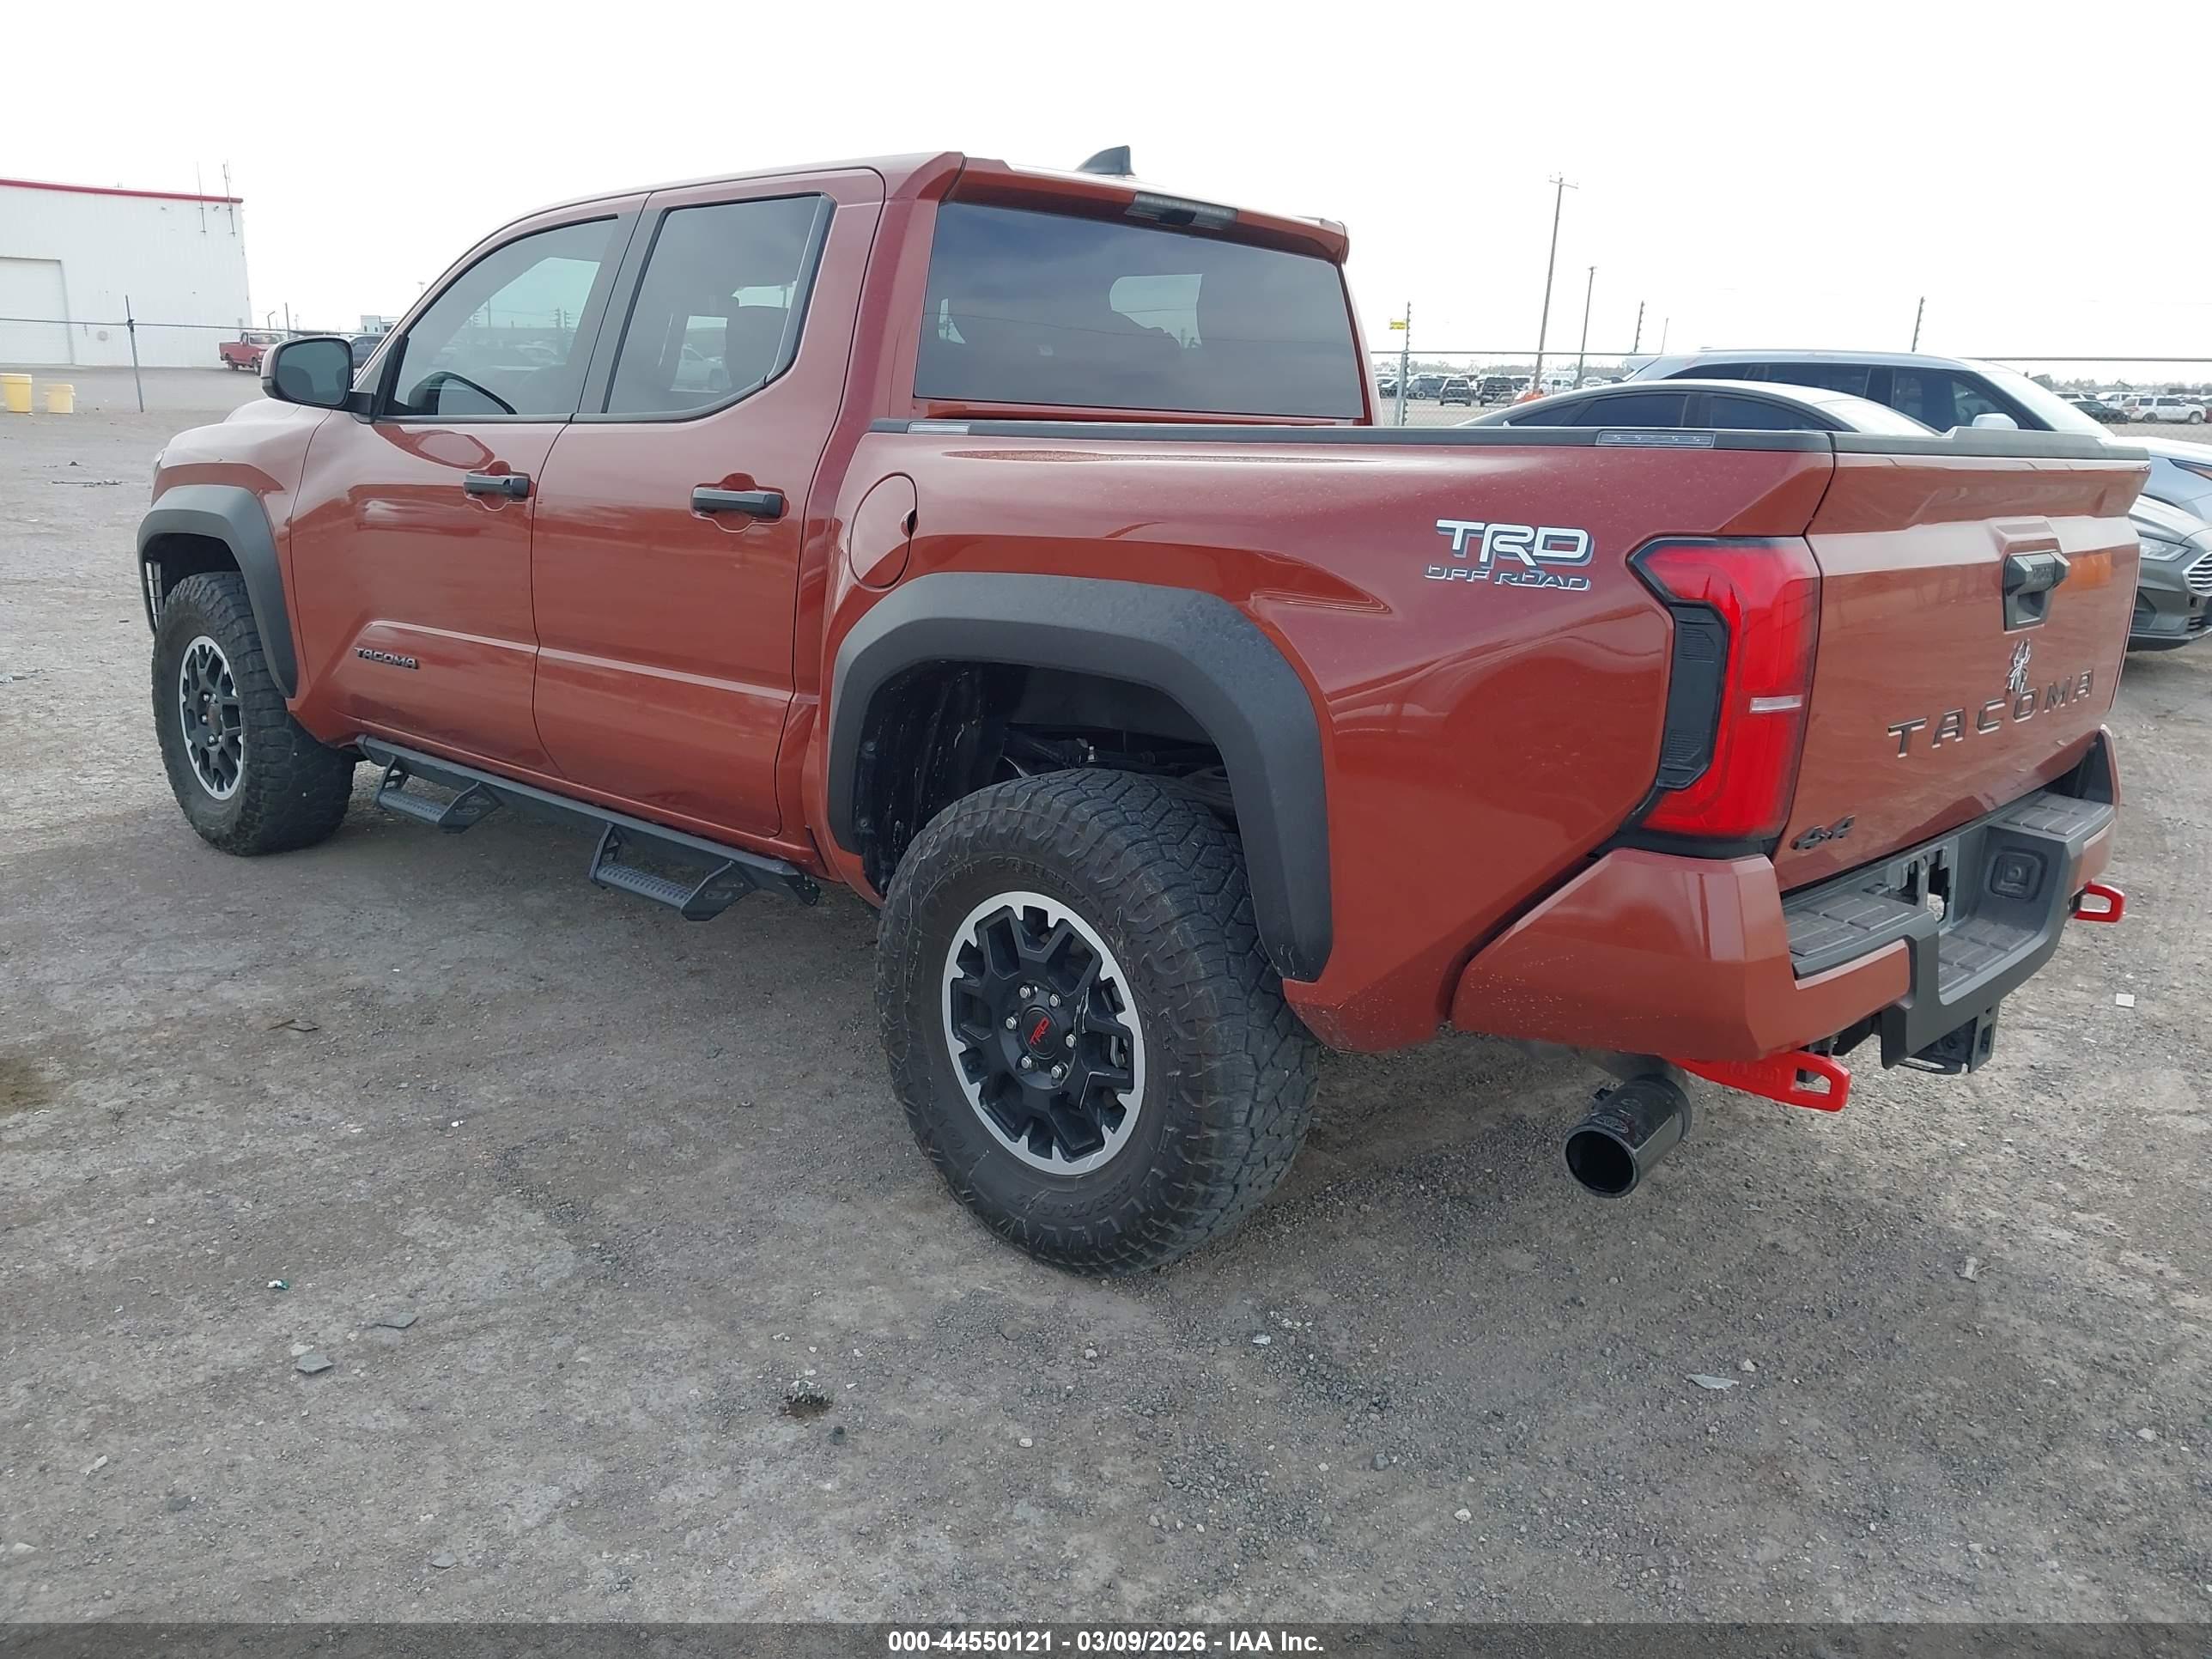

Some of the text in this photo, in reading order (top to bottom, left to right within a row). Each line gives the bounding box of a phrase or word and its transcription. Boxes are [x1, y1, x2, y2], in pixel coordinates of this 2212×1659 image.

[1435, 519, 1595, 568] TRD
[1424, 564, 1592, 592] OFF ROAD
[353, 647, 419, 670] TACOMA
[1887, 669, 2095, 759] TACOMA
[1029, 1017, 1050, 1045] TRD
